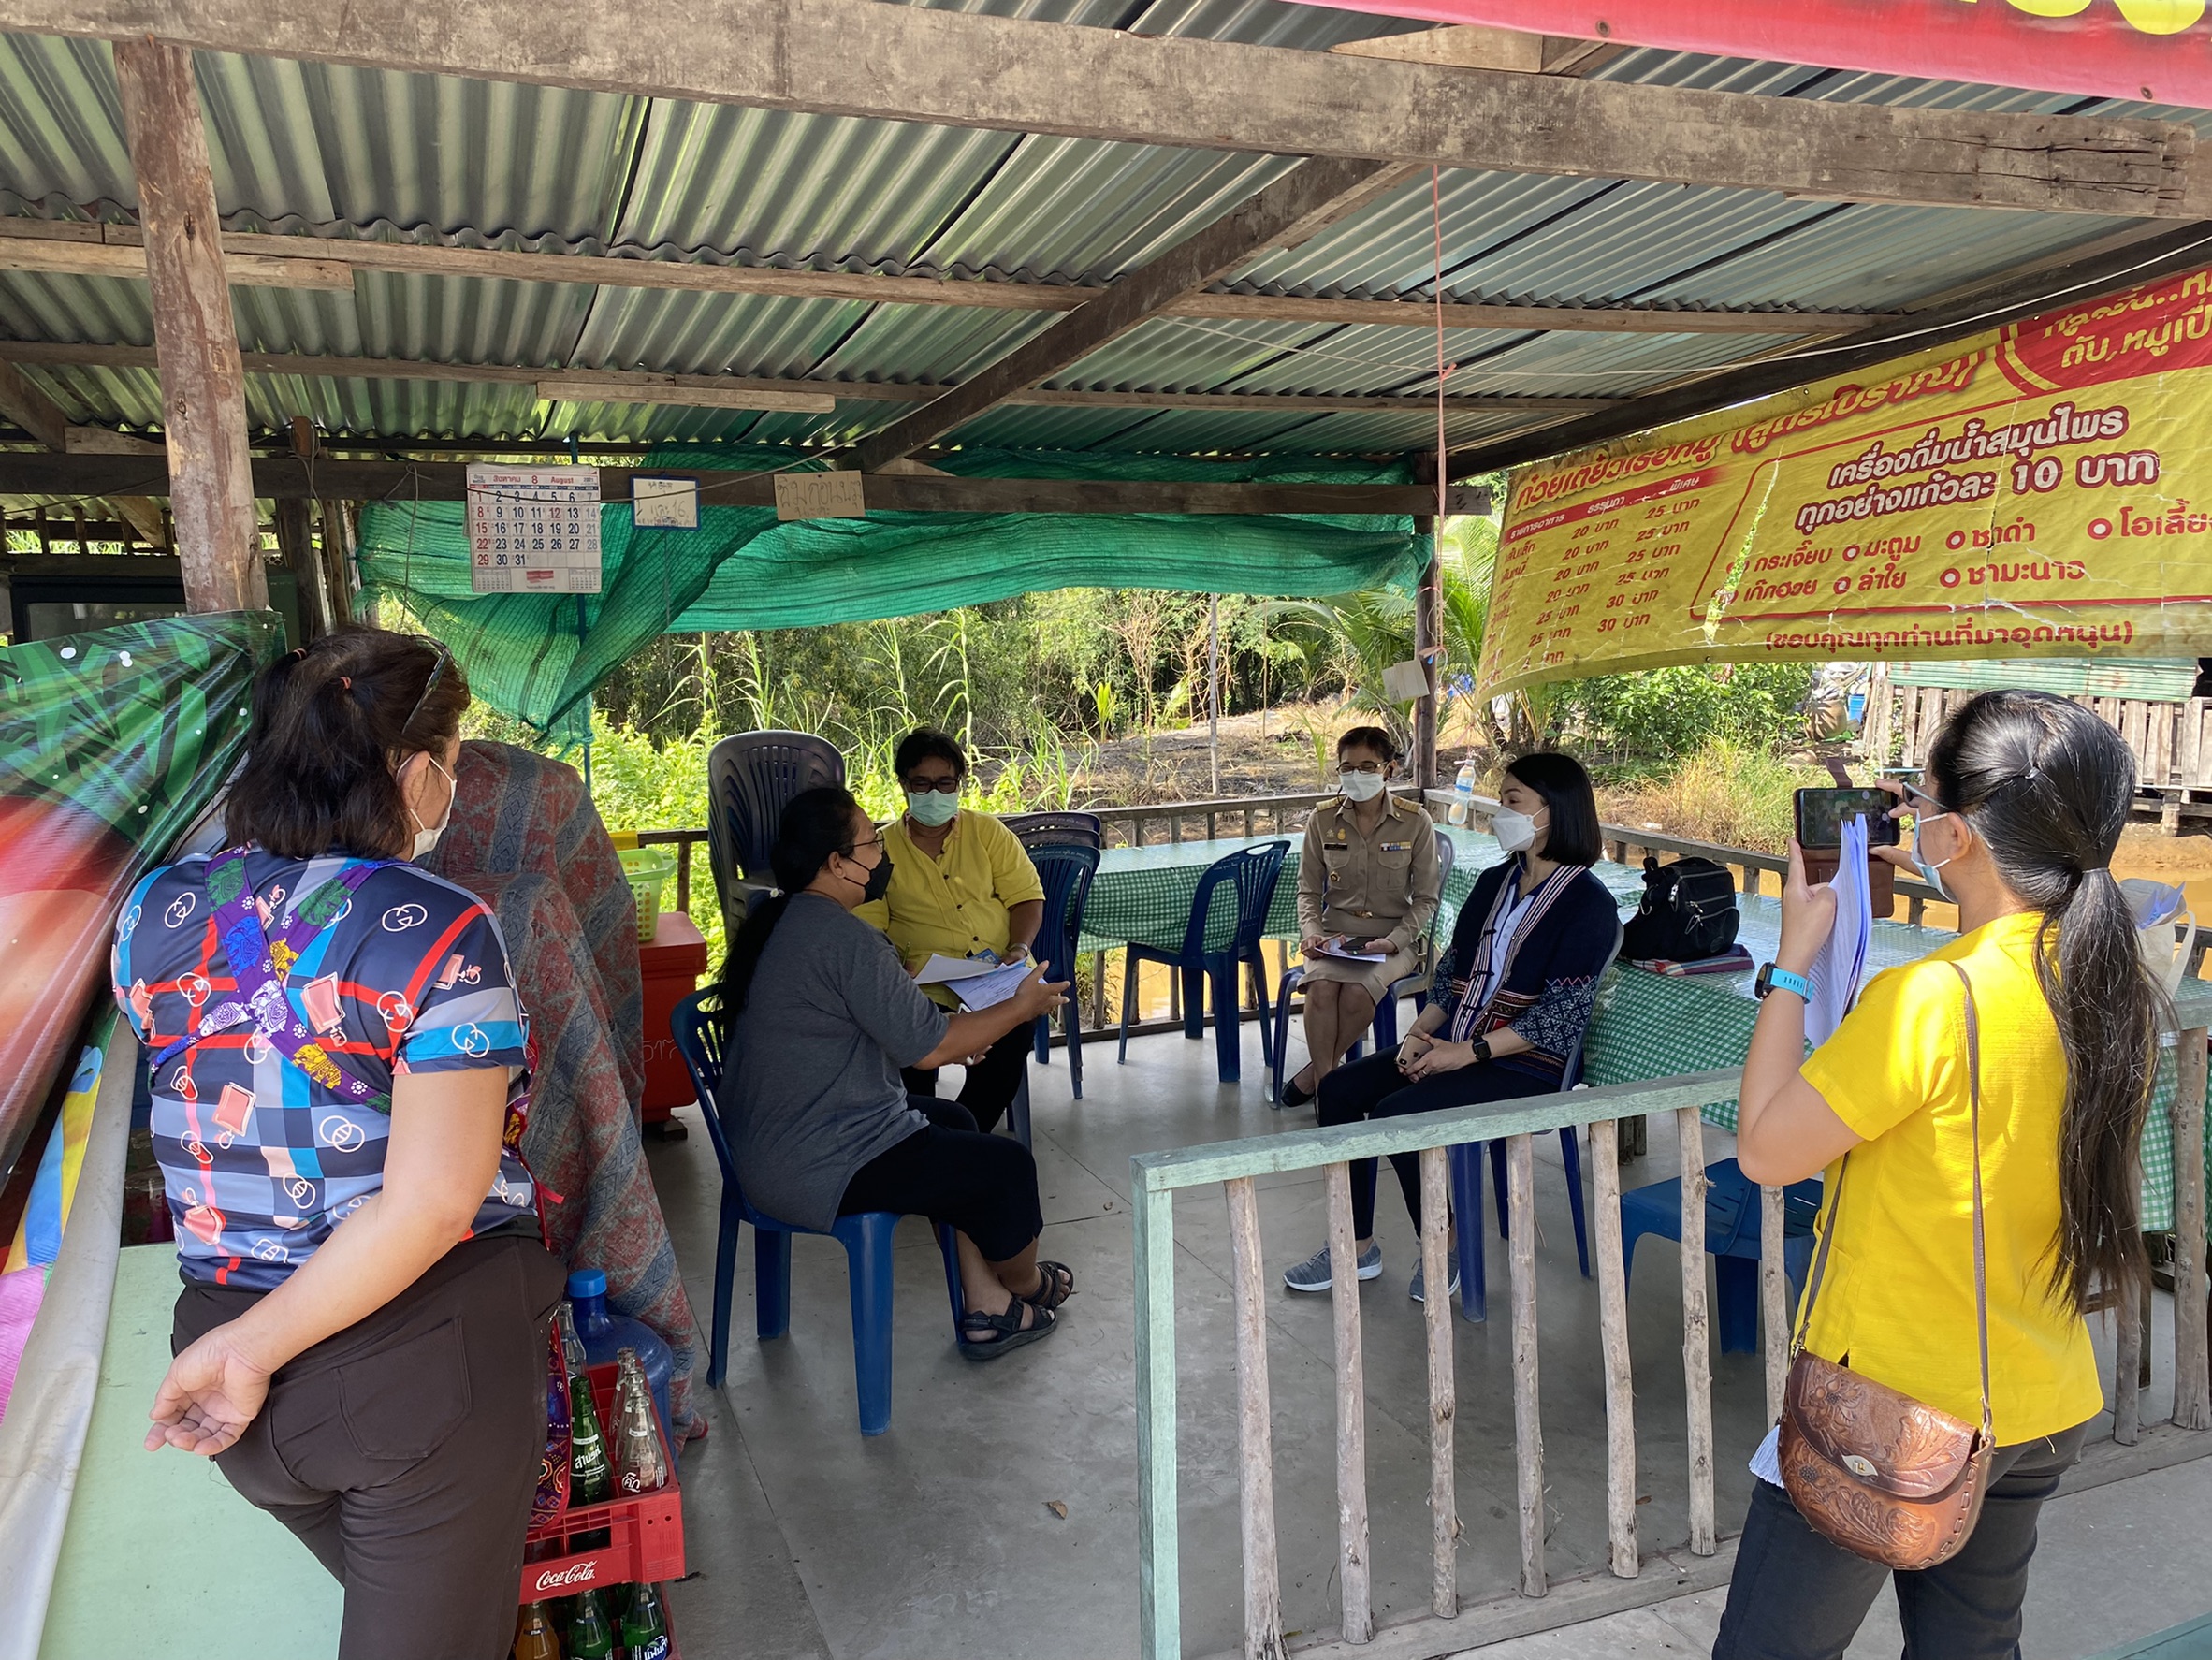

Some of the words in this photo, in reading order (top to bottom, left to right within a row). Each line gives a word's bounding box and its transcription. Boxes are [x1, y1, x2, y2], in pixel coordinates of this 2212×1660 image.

[1829, 404, 2125, 488] เครื่องดื่มน้ำสมุนไพร
[477, 491, 483, 502] 1
[495, 490, 502, 502] 2
[514, 490, 521, 502] 3
[532, 491, 540, 502] 4
[550, 492, 558, 502] 5
[568, 492, 575, 502] 6
[587, 492, 593, 502] 7
[531, 474, 539, 485] 8
[1798, 471, 1995, 533] ทุกอย่างแก้วละ
[2014, 459, 2059, 492] 10
[2080, 453, 2156, 485] บาท
[476, 522, 488, 534] 15
[494, 522, 506, 534] 16
[513, 522, 524, 534] 17
[531, 522, 543, 534] 18
[550, 522, 561, 534] 19
[568, 522, 580, 534] 20
[586, 523, 597, 534] 21
[477, 506, 484, 518] 8
[496, 506, 502, 518] 9
[513, 506, 524, 518] 10
[531, 507, 542, 518] 11
[549, 507, 560, 519] 12
[567, 507, 579, 519] 13
[586, 507, 597, 519] 14
[1509, 514, 1565, 540] รายการอาหาร
[1571, 527, 1589, 541] 20
[1594, 518, 1620, 533] บาท
[1644, 505, 1666, 520] 25
[1672, 498, 1700, 515] บาท
[476, 538, 488, 550] 22
[495, 538, 507, 550] 23
[514, 538, 526, 550] 24
[532, 538, 544, 550] 25
[551, 538, 562, 550] 26
[569, 538, 580, 550] 27
[587, 539, 598, 550] 28
[1562, 547, 1580, 561] 20
[1586, 539, 1609, 555] บาท
[1635, 528, 1655, 543] 25
[1662, 520, 1691, 536] บาท
[1754, 539, 1833, 573] กระเจี๊ยบ
[1864, 535, 1921, 561] มะตูม
[1972, 517, 2036, 547] ชาดำ
[2119, 498, 2212, 537] โอเลี้ย
[477, 554, 489, 566] 29
[496, 554, 508, 566] 30
[515, 554, 526, 566] 31
[1553, 569, 1572, 582] 20
[1576, 561, 1600, 576] บาท
[1625, 549, 1645, 564] 25
[1652, 544, 1681, 559] บาท
[1545, 590, 1563, 604] 20
[1566, 583, 1591, 598] บาท
[1614, 572, 1636, 586] 25
[1643, 566, 1670, 582] บาท
[1743, 578, 1818, 603] เก๊กฮวย
[1857, 562, 1907, 591] ลำใย
[1967, 560, 2086, 585] ชามะนาว
[1535, 613, 1554, 626] 25
[1557, 604, 1580, 619] บาท
[1605, 593, 1625, 609] 30
[1632, 589, 1660, 605] บาท
[1528, 633, 1545, 648] 25
[1549, 627, 1572, 641] บาท
[1597, 618, 1617, 633] 30
[1623, 613, 1651, 630] บาท
[1766, 616, 2134, 653] (ขอบคุณทุกท่านที่มาอุดหนุน)
[535, 1560, 598, 1591] Coca-Cola
